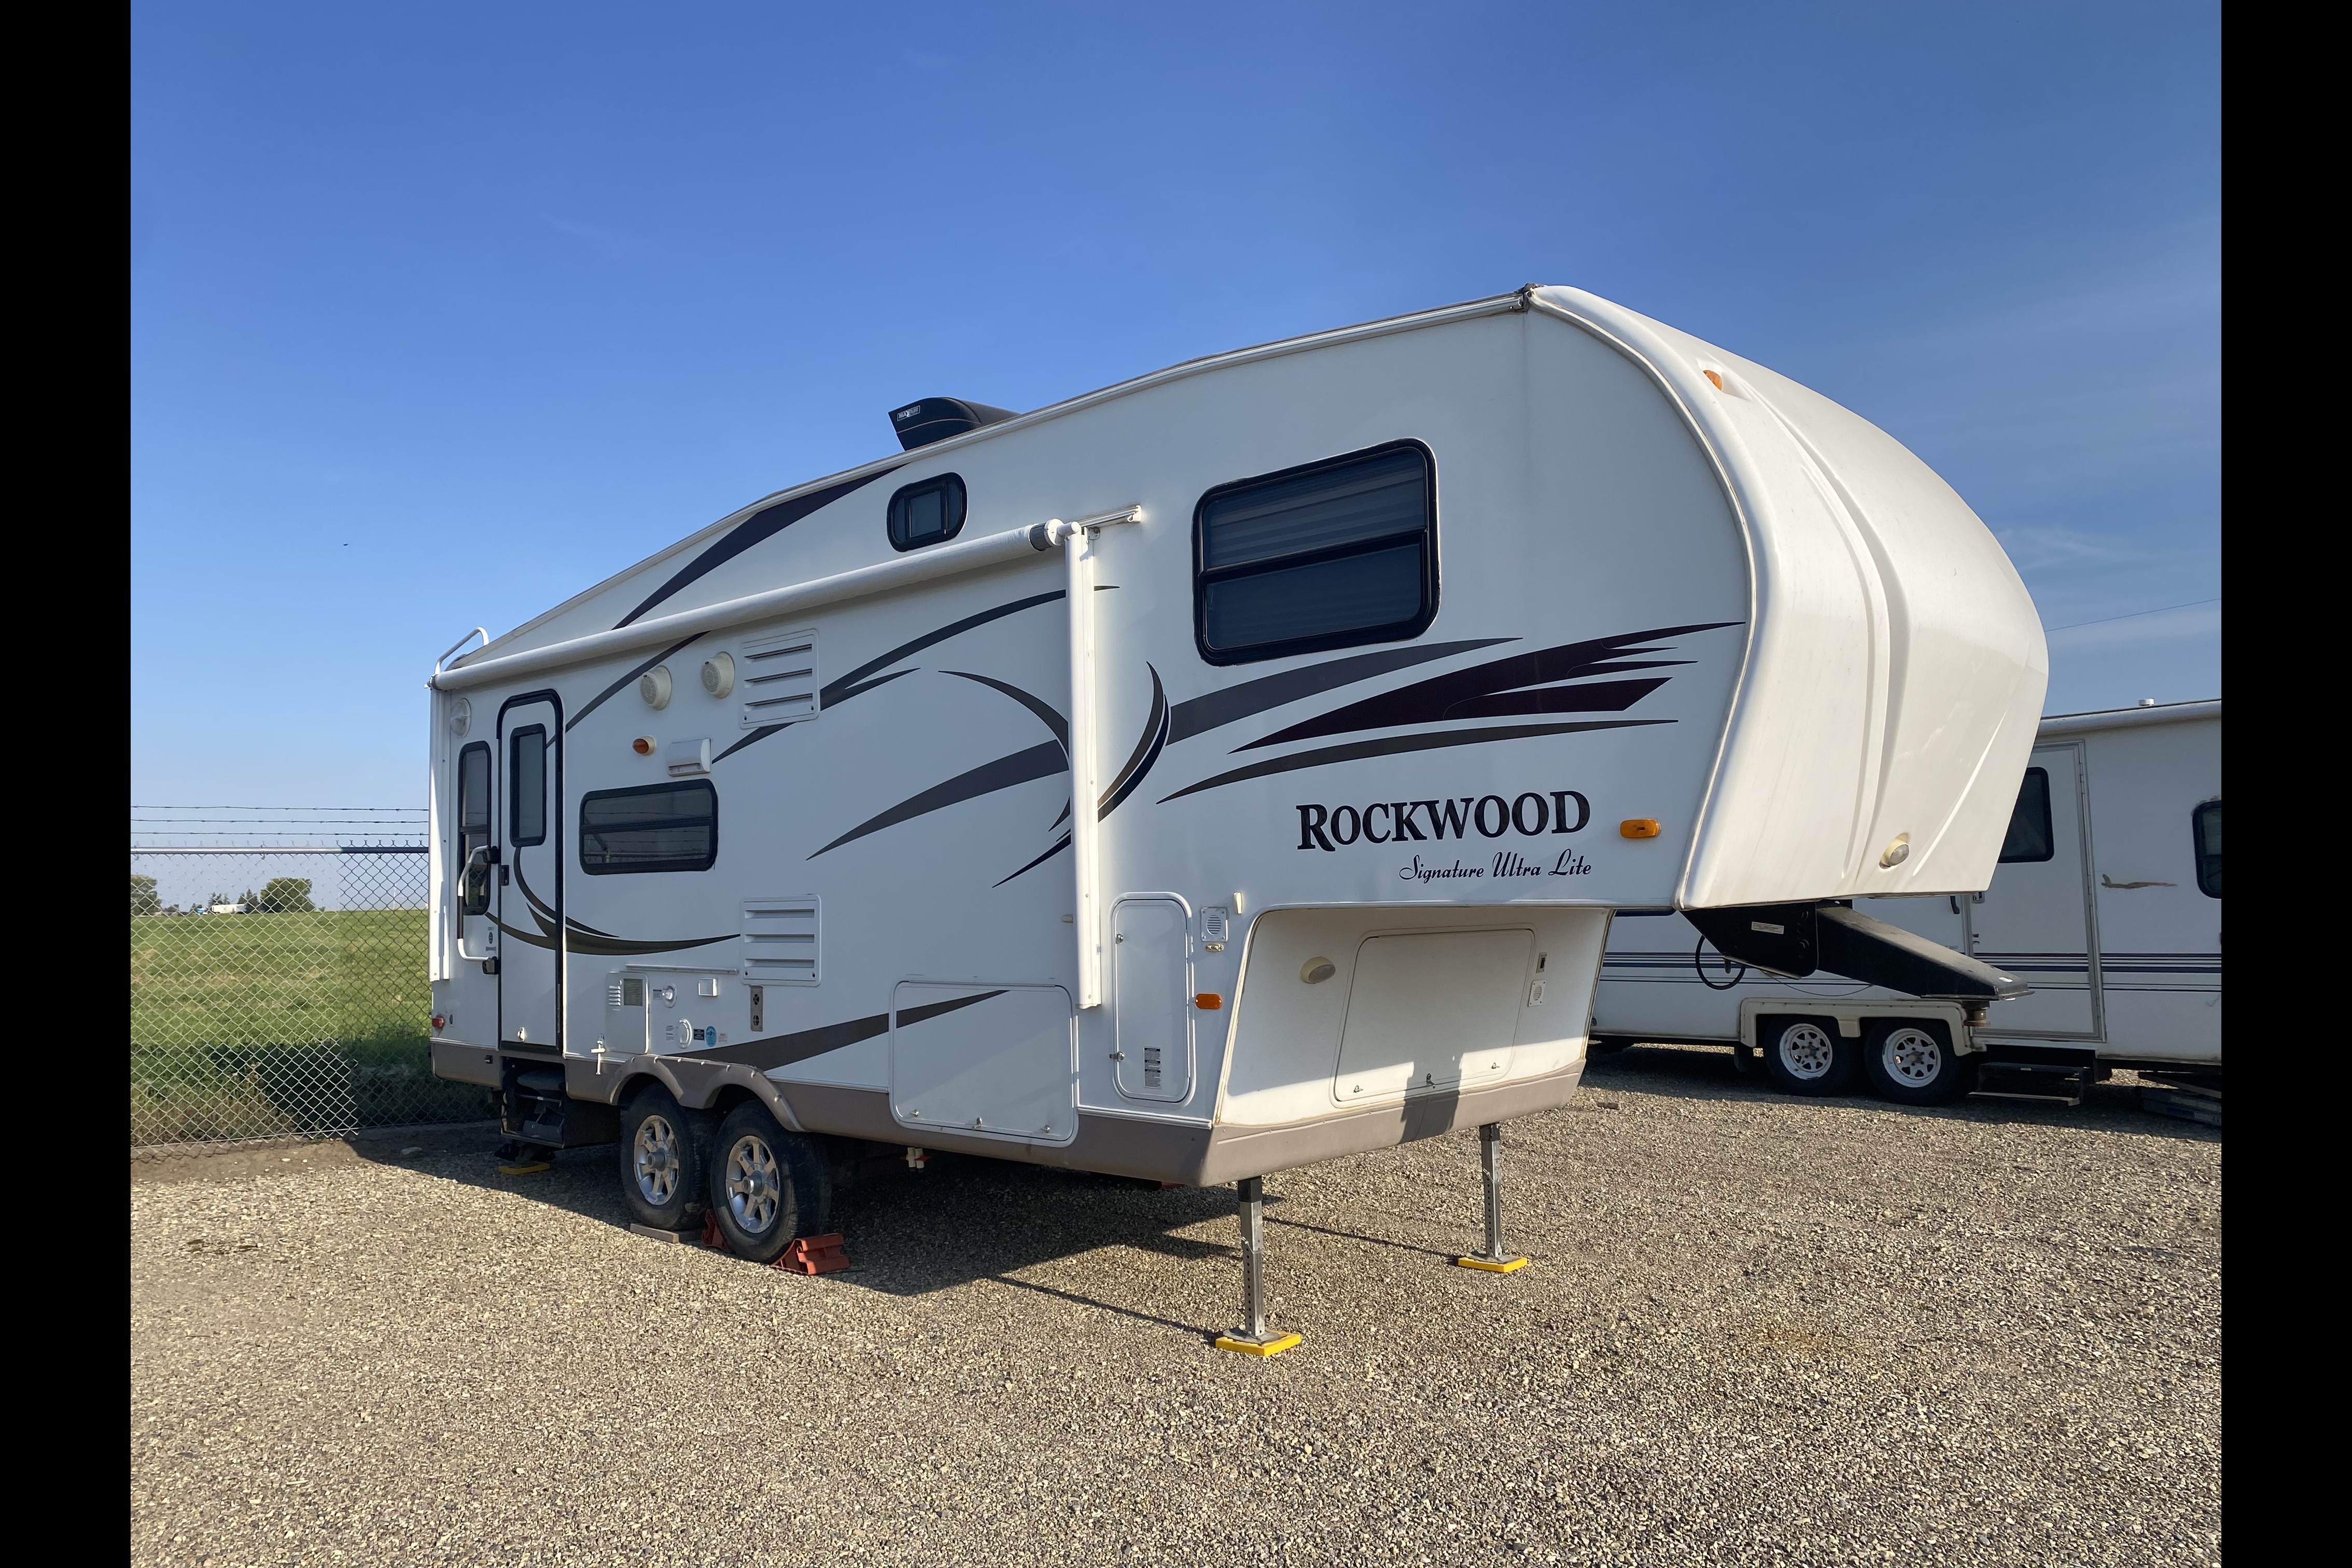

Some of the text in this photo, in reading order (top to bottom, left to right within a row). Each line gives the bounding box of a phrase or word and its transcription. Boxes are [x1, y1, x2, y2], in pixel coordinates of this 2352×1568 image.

[1296, 790, 1591, 852] ROCKWOOD
[1399, 848, 1592, 884] Signature Ultra Lite
